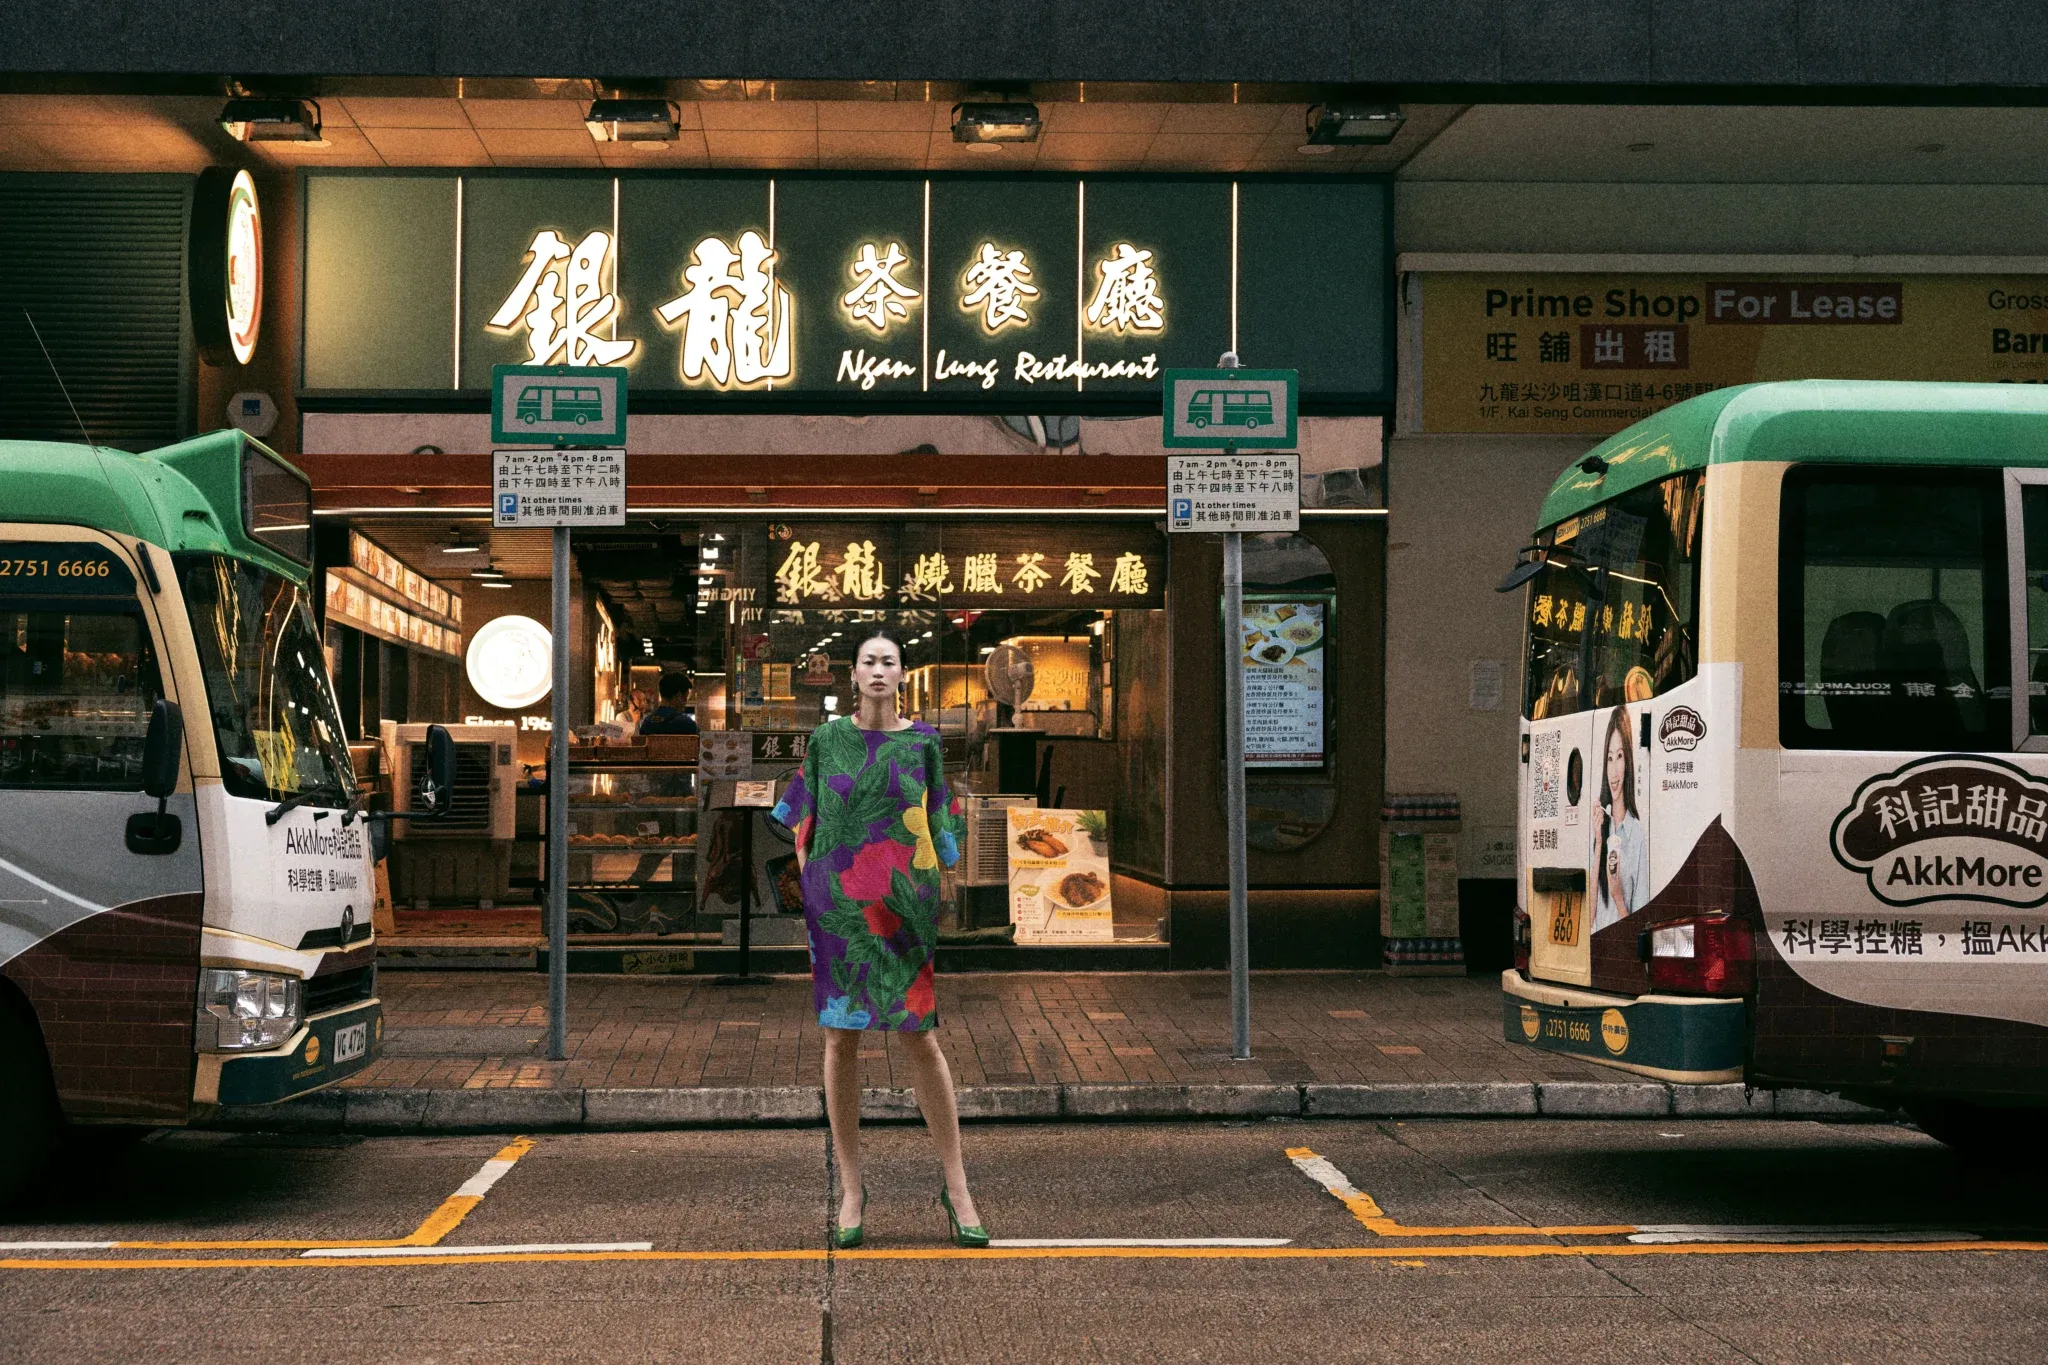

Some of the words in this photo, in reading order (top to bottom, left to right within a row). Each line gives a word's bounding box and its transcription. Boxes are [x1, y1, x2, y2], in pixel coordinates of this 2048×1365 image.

[487, 230, 1165, 384] 銀龍茶餐廳
[1485, 289, 1592, 318] Prime
[1604, 289, 1700, 323] Shop
[1714, 289, 1776, 318] For
[1790, 289, 1897, 319] Lease
[837, 349, 916, 390] Ngan
[935, 349, 999, 389] Lung
[1015, 350, 1159, 384] Restaurant
[1509, 406, 1530, 418] Kai
[1534, 406, 1568, 421] Seng
[540, 456, 553, 464] pm
[1214, 461, 1227, 469] pm
[1274, 460, 1287, 468] pm
[500, 464, 620, 476] 由上午七時至下午二時
[1173, 469, 1294, 481] 由上午七時至下午二時
[500, 477, 620, 488] 由下午四時至下午八時
[1173, 482, 1294, 494] 由下午四時至下午八時
[502, 496, 514, 512] P
[521, 496, 531, 504] At
[533, 496, 556, 504] other
[558, 496, 582, 504] times
[522, 505, 619, 516] 其他時間則准泊車
[1176, 502, 1188, 517] P
[1196, 510, 1293, 522] 其他時間則准泊車
[0, 559, 50, 577] 2751
[58, 559, 110, 577] 6666
[520, 716, 553, 731] 196
[1665, 714, 1696, 733] 科記甜品
[1666, 736, 1695, 747] AkkMore
[1666, 762, 1694, 774] 科學控糖
[1872, 784, 2048, 843] 科記甜品
[1886, 855, 2043, 888] AkkMore
[1558, 893, 1573, 918] LN
[1553, 918, 1573, 943] 860
[1549, 1018, 1567, 1038] 2751
[1569, 1021, 1590, 1042] 6666
